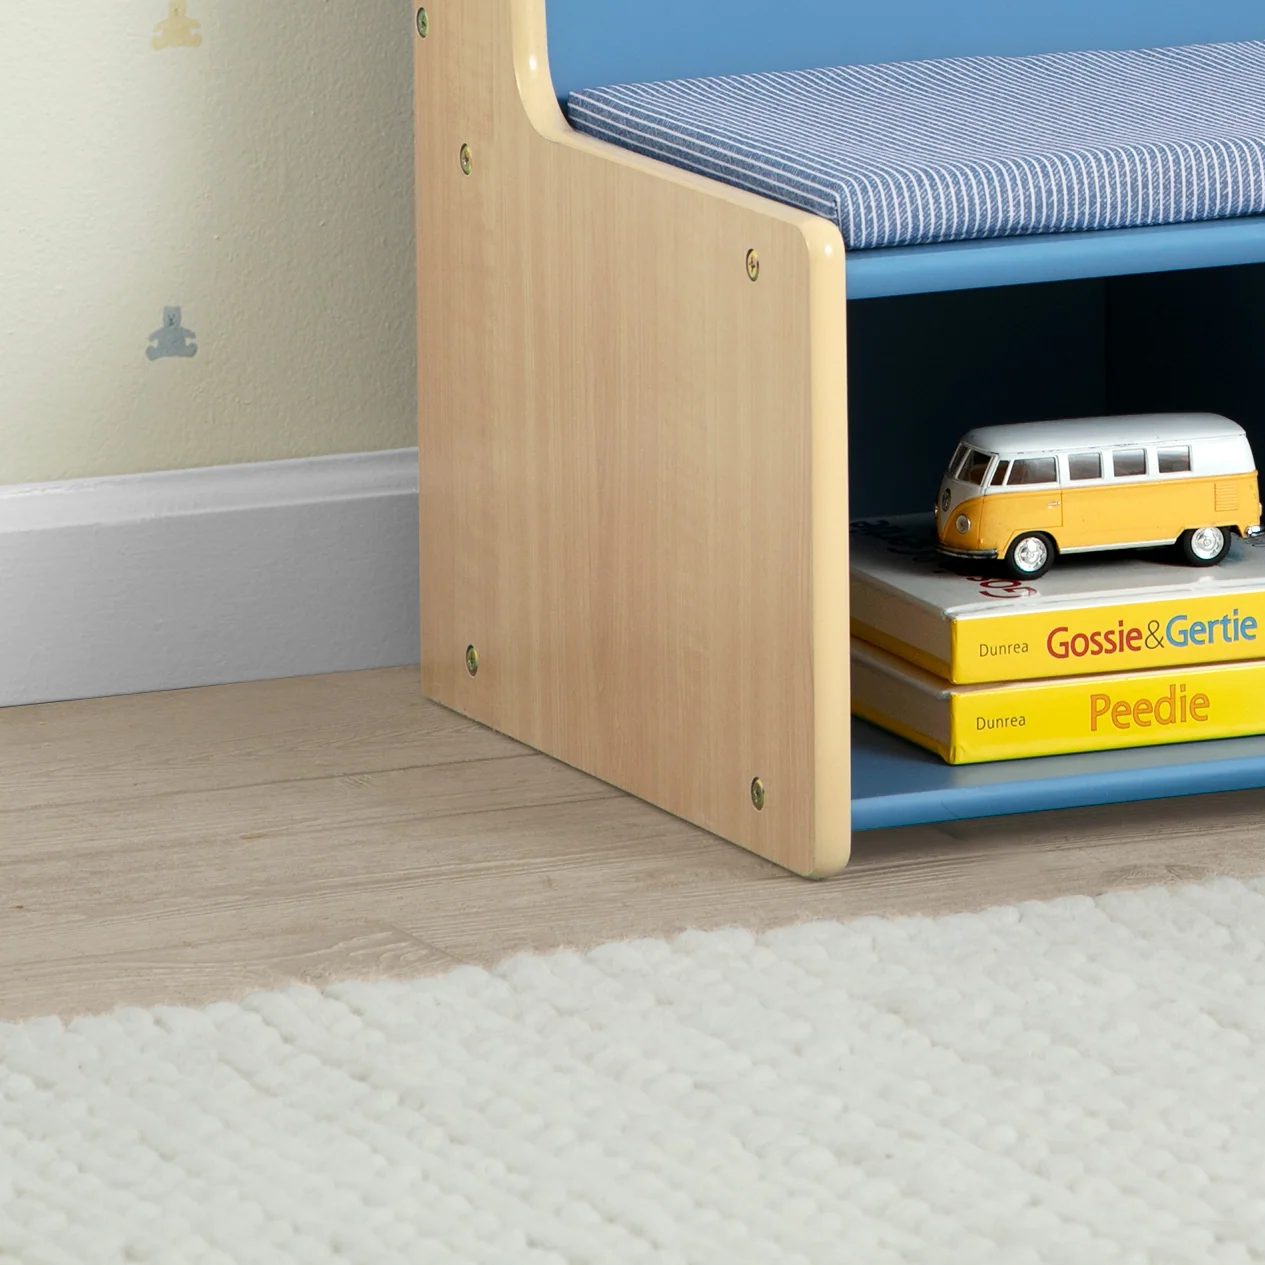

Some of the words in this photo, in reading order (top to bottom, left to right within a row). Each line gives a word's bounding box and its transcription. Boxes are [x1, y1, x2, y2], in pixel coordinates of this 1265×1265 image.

[979, 640, 1029, 658] Dunrea
[1046, 608, 1258, 660] Gossie&Gertie
[976, 713, 1026, 732] Dunrea
[1089, 684, 1210, 732] Peedie
